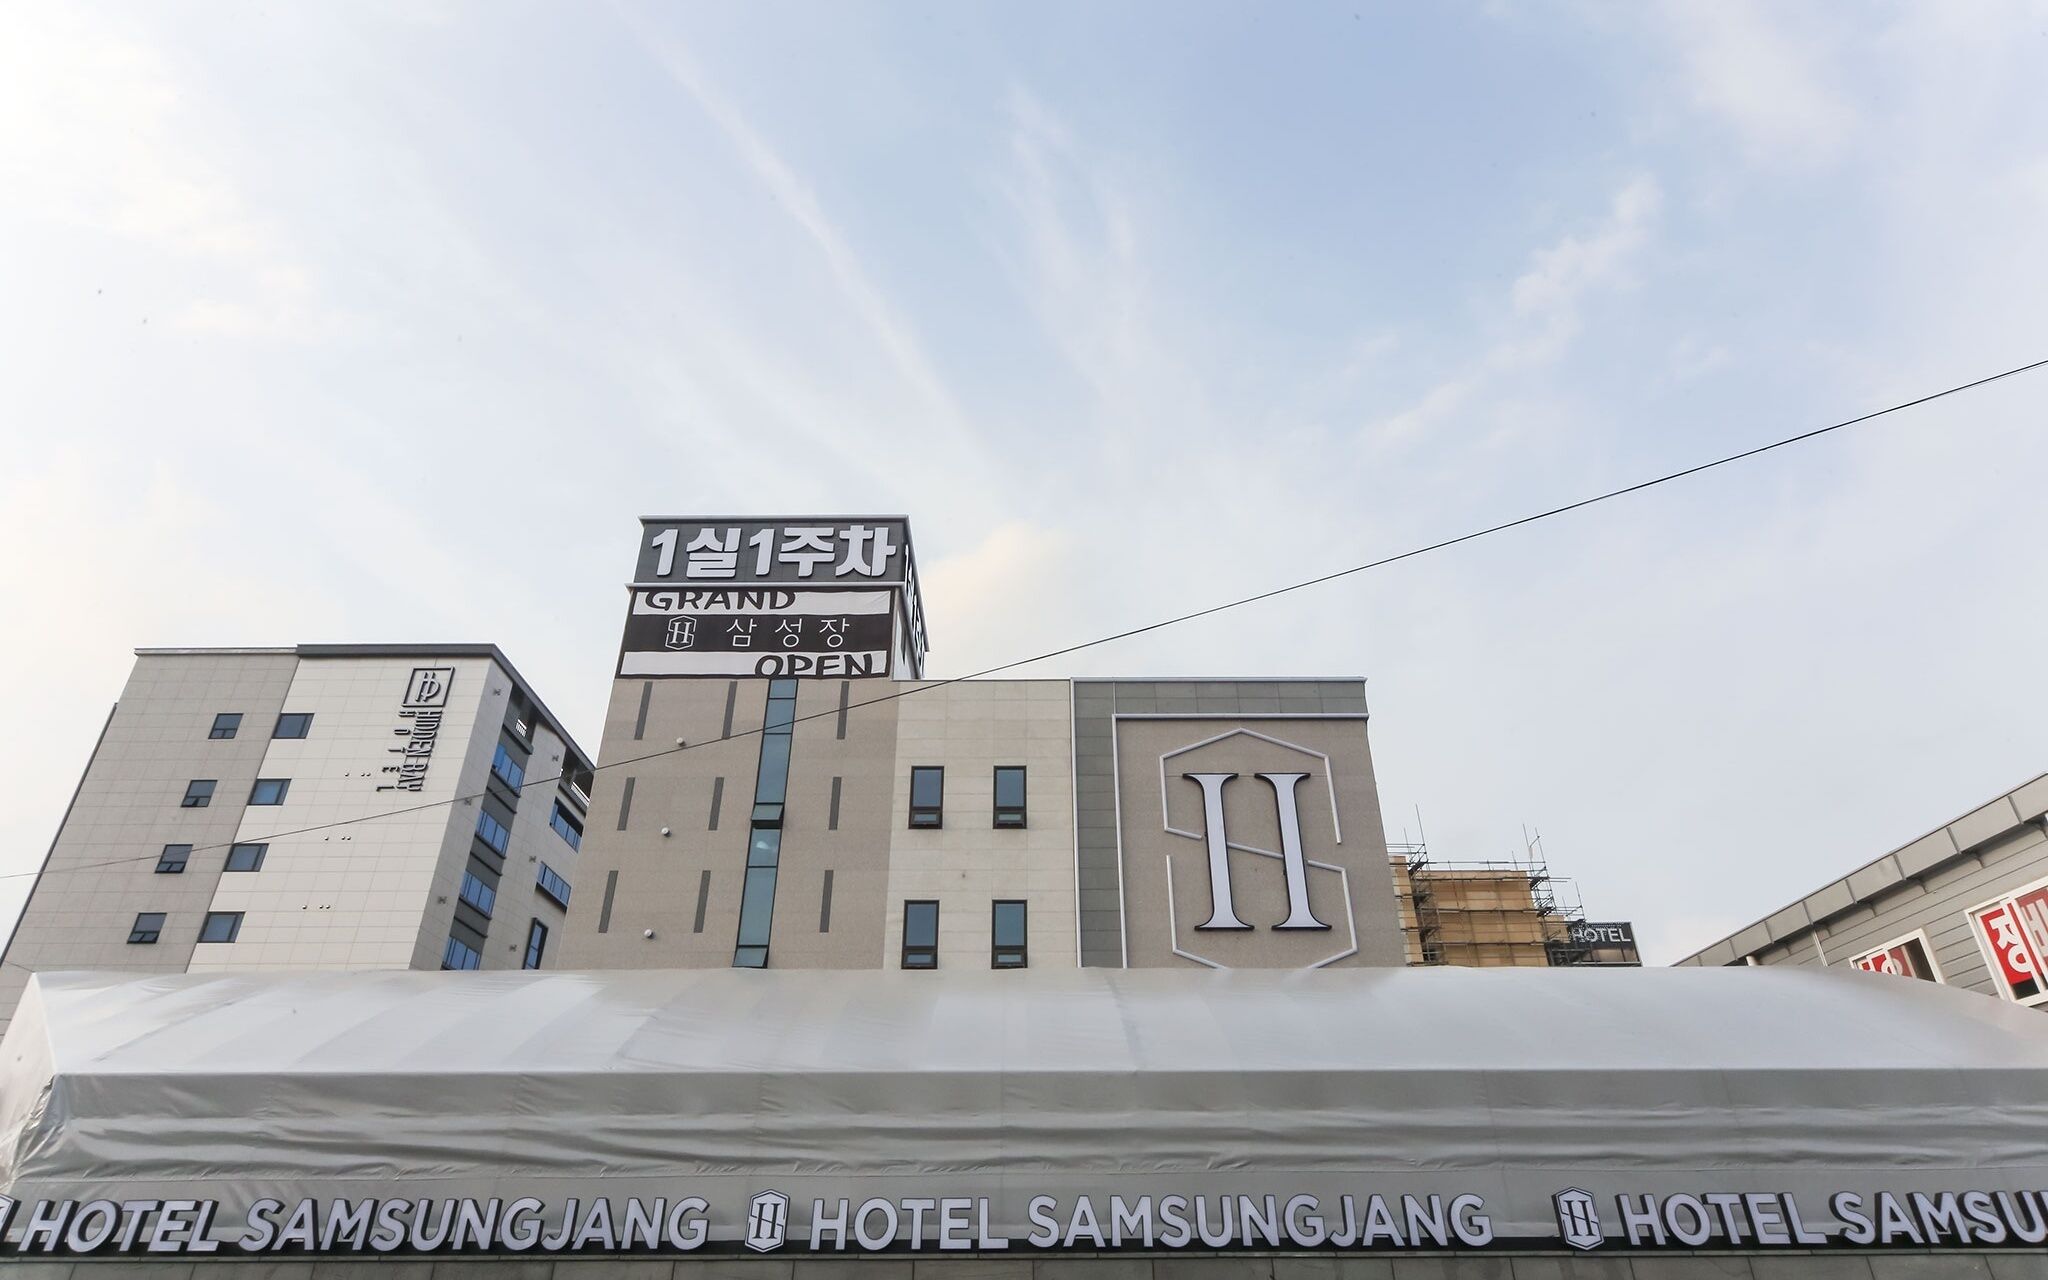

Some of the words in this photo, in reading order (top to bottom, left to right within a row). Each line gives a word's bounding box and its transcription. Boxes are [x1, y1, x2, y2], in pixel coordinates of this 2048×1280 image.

[651, 524, 897, 578] 1실1주차
[645, 591, 796, 611] GRAND
[754, 653, 874, 677] OPEN
[376, 710, 417, 792] HOTEL
[405, 710, 443, 758] HIDDEN
[397, 763, 428, 792] BAY
[1572, 927, 1632, 943] HOTEL
[18, 1200, 219, 1252] HOTEL
[239, 1198, 710, 1252] SAMSUNGJANG
[810, 1197, 1008, 1251] HOTEL
[1027, 1193, 1493, 1248] SAMSUNGJANG
[1615, 1192, 1827, 1246] HOTEL
[1829, 1190, 2048, 1245] SAMSU
